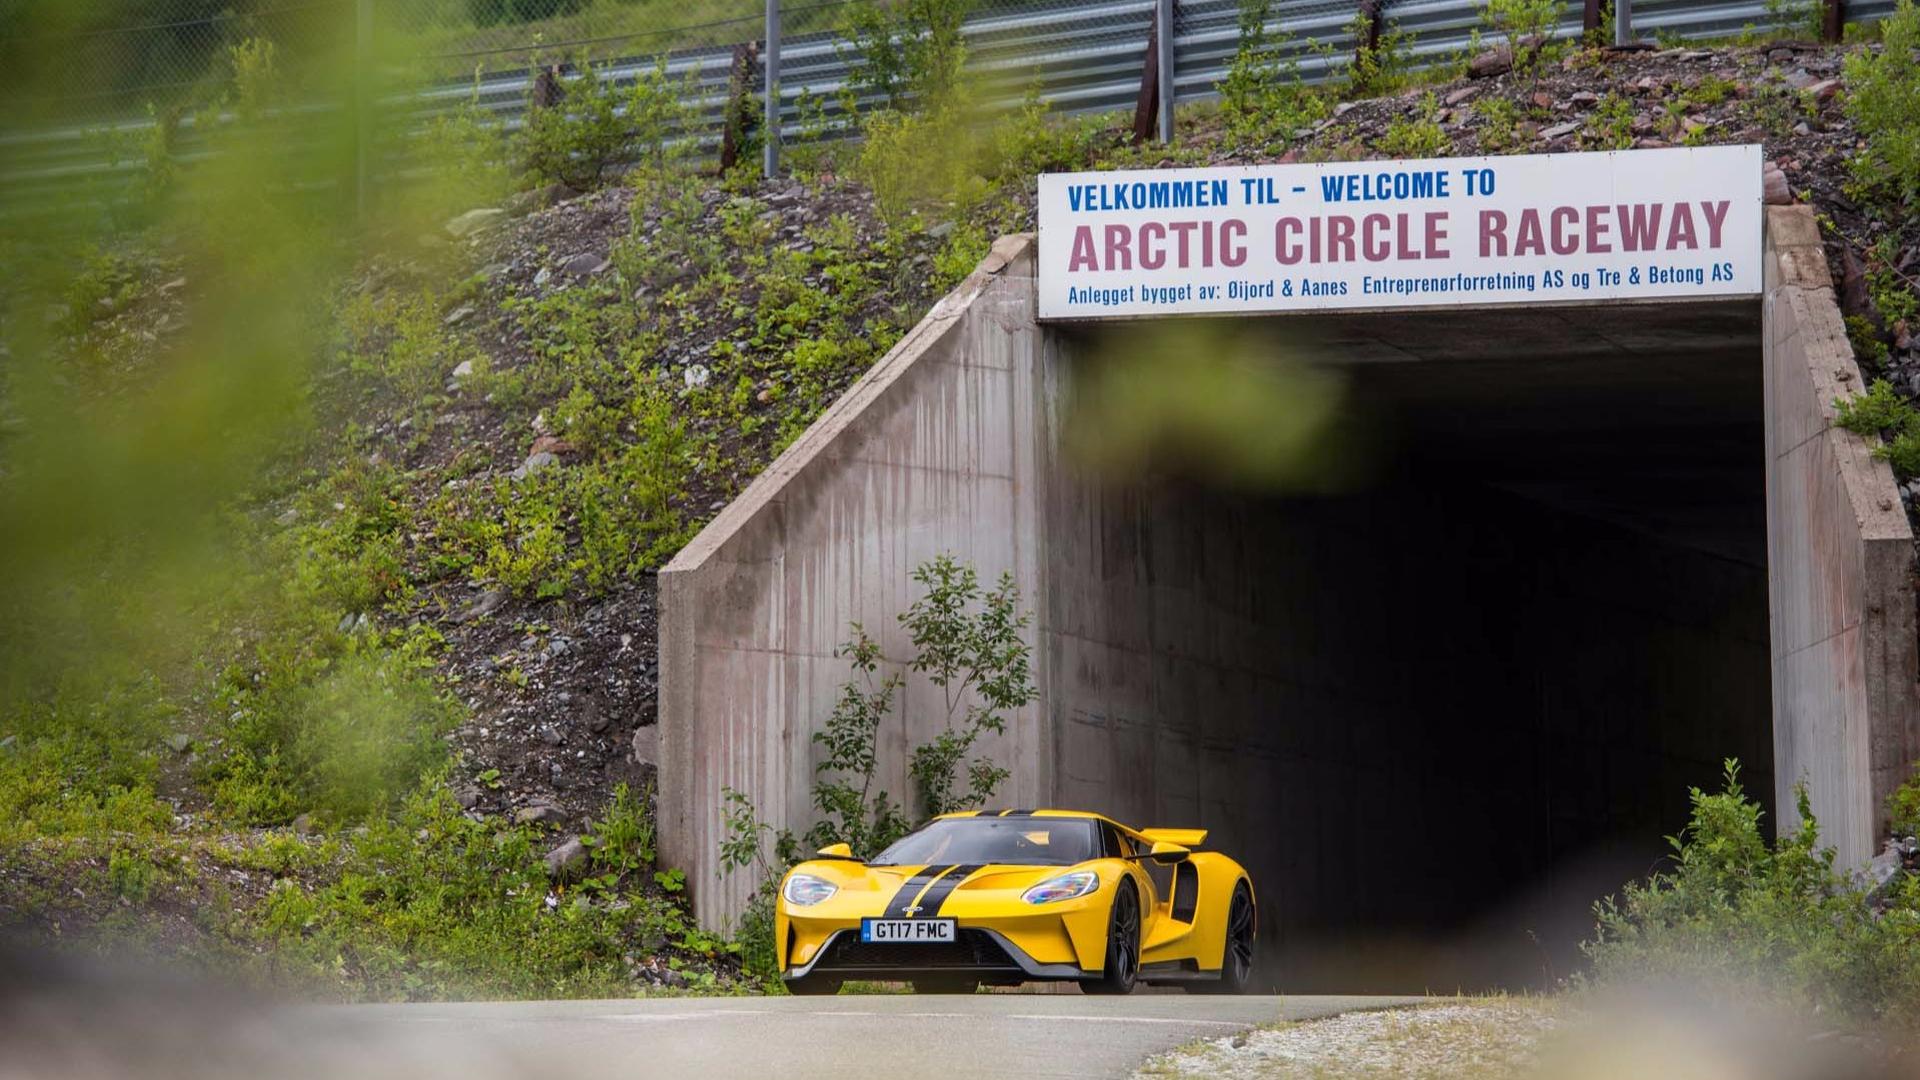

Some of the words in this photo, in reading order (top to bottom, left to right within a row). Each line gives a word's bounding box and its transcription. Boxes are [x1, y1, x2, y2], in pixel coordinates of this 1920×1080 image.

[1068, 179, 1228, 212] VELKOMMEN
[1240, 177, 1279, 206] TIL
[1321, 170, 1450, 203] WELCOME
[1462, 167, 1495, 197] TO
[1069, 218, 1247, 272] ARCTIC
[1276, 211, 1450, 265] CIRCLE
[1479, 200, 1730, 257] RACEWAY
[1068, 281, 1134, 306] Anlegget
[1141, 283, 1191, 305] bygget
[1200, 285, 1220, 300] av:
[1229, 279, 1274, 302] Øijord
[1282, 278, 1294, 298] &
[1301, 277, 1348, 296] Aanes
[1363, 272, 1535, 296] Entreprenørforretning
[1543, 269, 1565, 289] AS
[1572, 272, 1590, 291] og
[1596, 267, 1621, 287] Tre
[1629, 265, 1641, 285] &
[1648, 265, 1704, 286] Betong
[1711, 262, 1734, 282] AS
[876, 922, 911, 938] GT17
[916, 922, 947, 938] FMC
